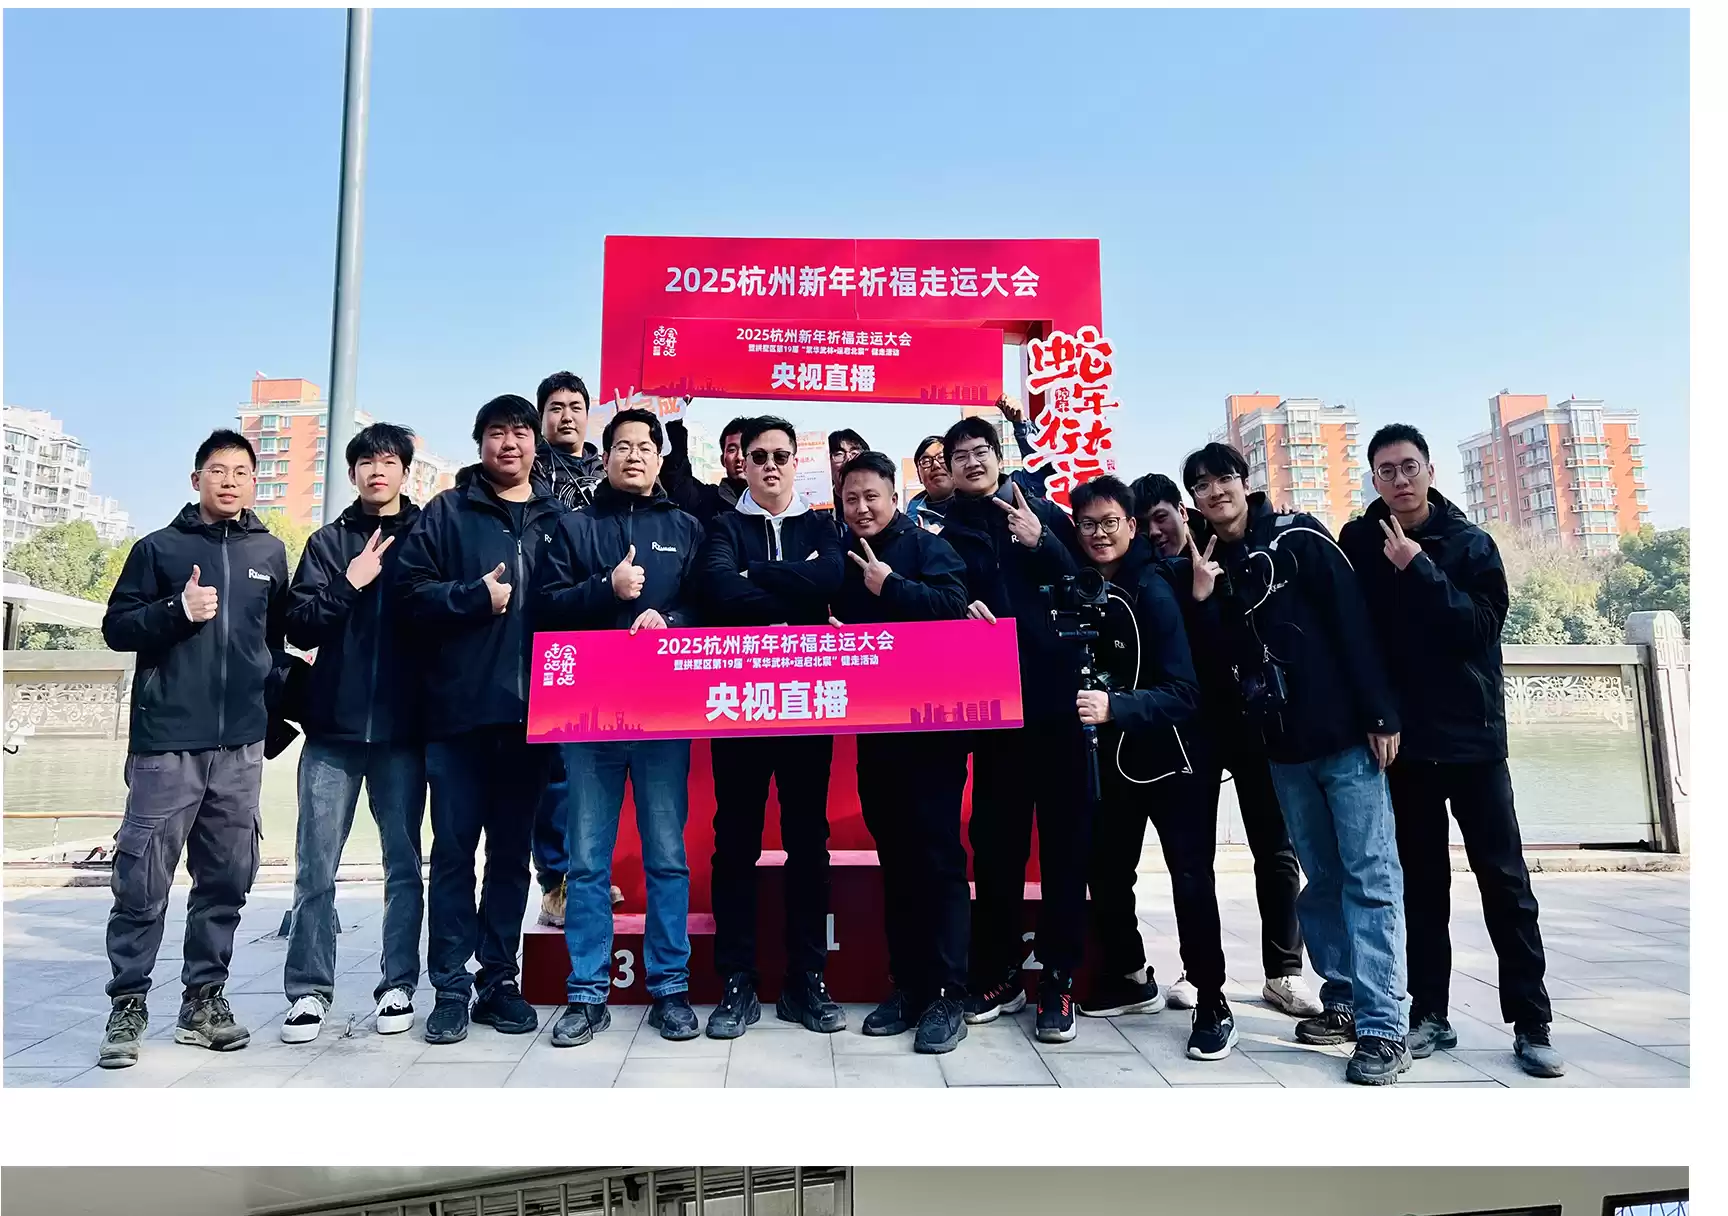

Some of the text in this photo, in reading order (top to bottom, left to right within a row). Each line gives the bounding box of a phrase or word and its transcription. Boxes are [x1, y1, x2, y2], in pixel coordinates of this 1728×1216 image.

[665, 265, 1040, 299] 2025杭州新年祈福走运大会
[736, 327, 912, 348] 2025杭州新年祈福走运大会
[771, 362, 875, 392] 央视直播
[657, 630, 895, 657] 2025杭州新年祈福走运大会
[705, 680, 849, 722] 央视直播
[612, 949, 635, 989] 3
